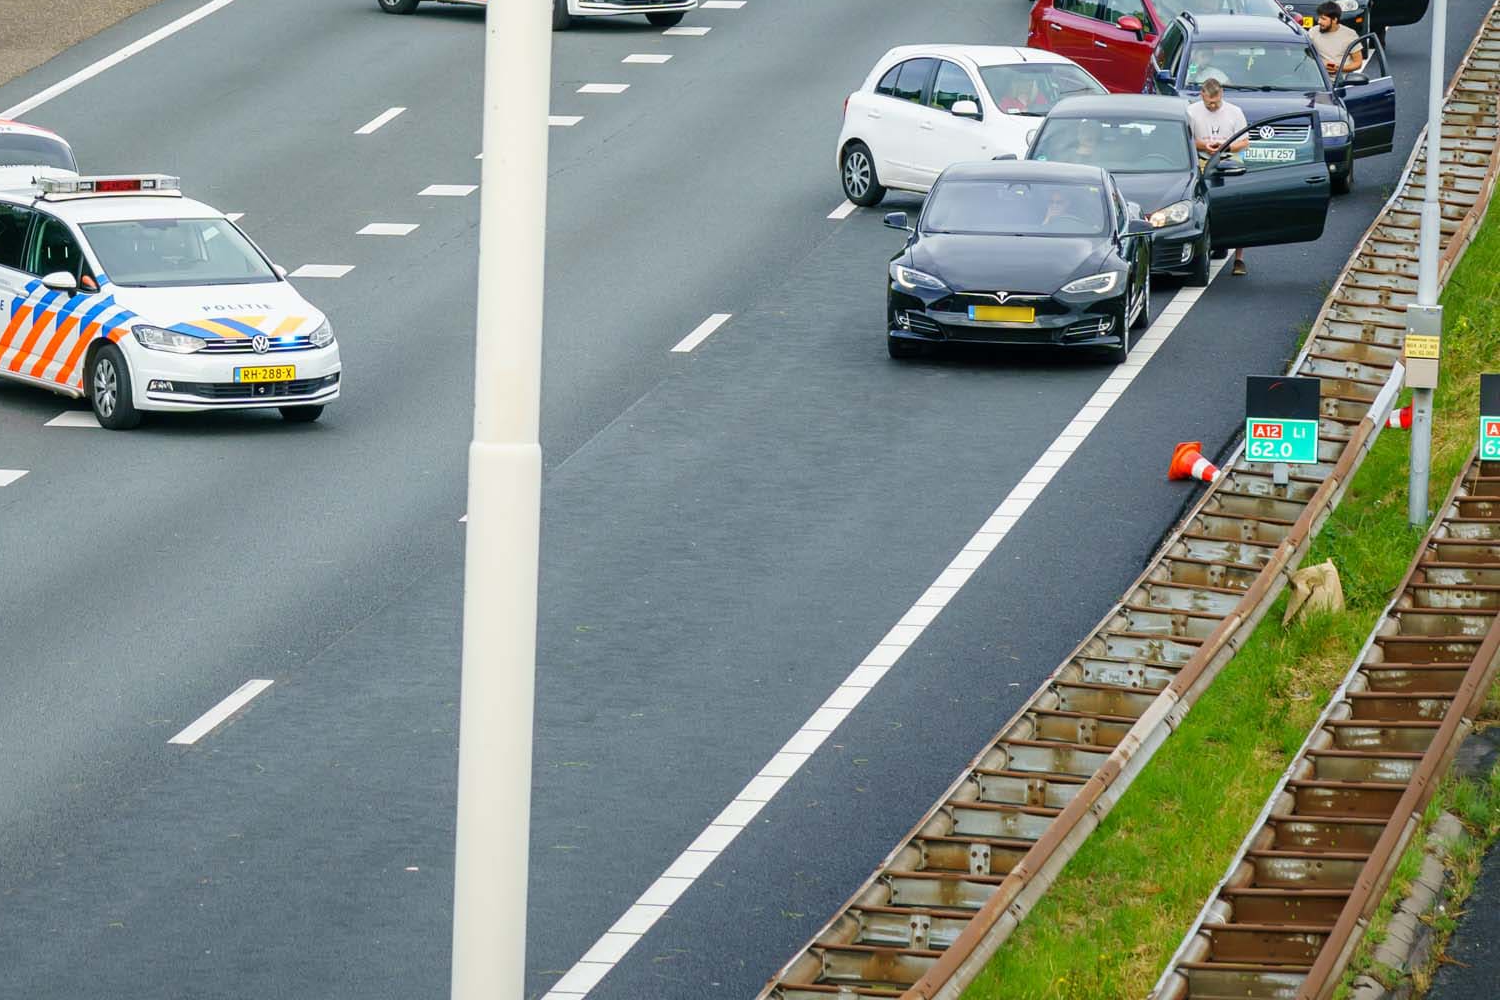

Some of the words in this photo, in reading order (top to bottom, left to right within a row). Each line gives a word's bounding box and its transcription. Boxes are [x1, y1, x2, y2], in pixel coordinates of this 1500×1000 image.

[1263, 149, 1275, 158] VT
[1277, 150, 1294, 159] 257
[243, 367, 293, 381] RH-288-X
[1255, 425, 1280, 437] A12
[1251, 442, 1293, 458] 62.0
